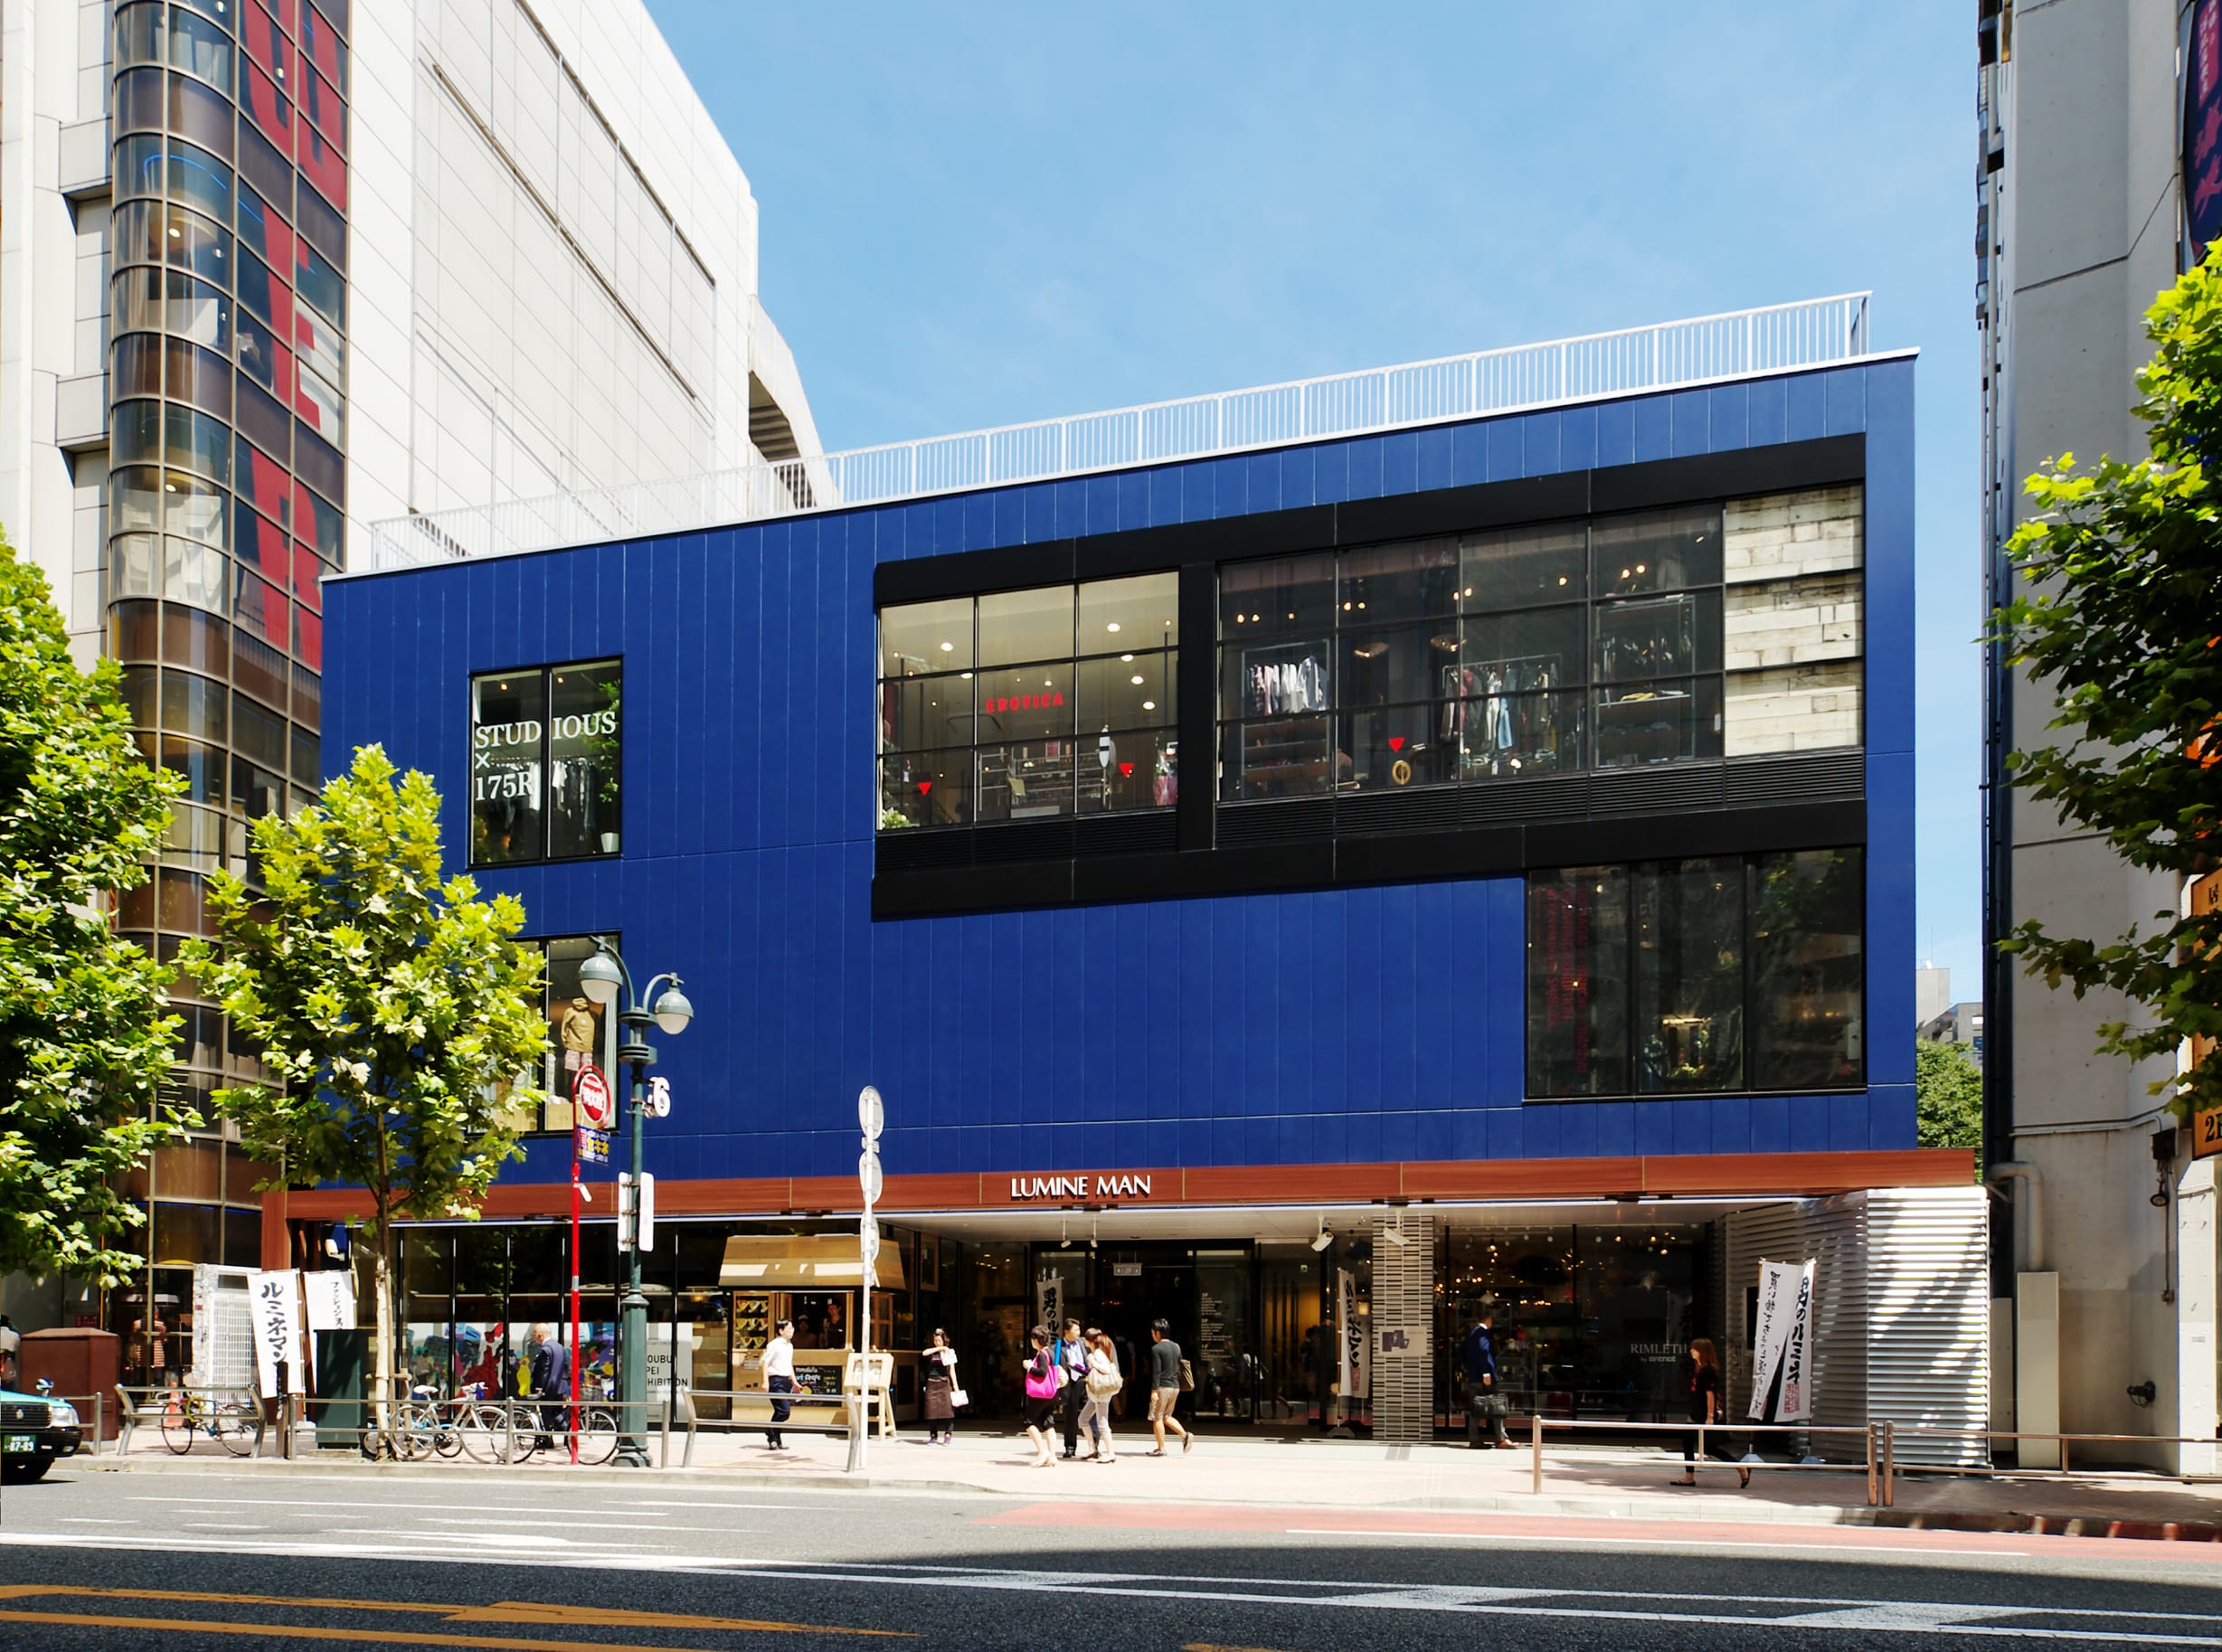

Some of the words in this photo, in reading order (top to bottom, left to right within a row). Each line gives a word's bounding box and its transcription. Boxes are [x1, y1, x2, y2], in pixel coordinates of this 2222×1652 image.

[986, 691, 1064, 714] EROTICA
[475, 771, 534, 801] 175R
[1011, 1175, 1089, 1198] LUMINE
[1096, 1175, 1151, 1195] MAN
[260, 1281, 288, 1366] ルミネマン
[646, 1366, 659, 1375] PEI
[647, 1355, 672, 1364] OUBU
[648, 1378, 688, 1386] HIBITON
